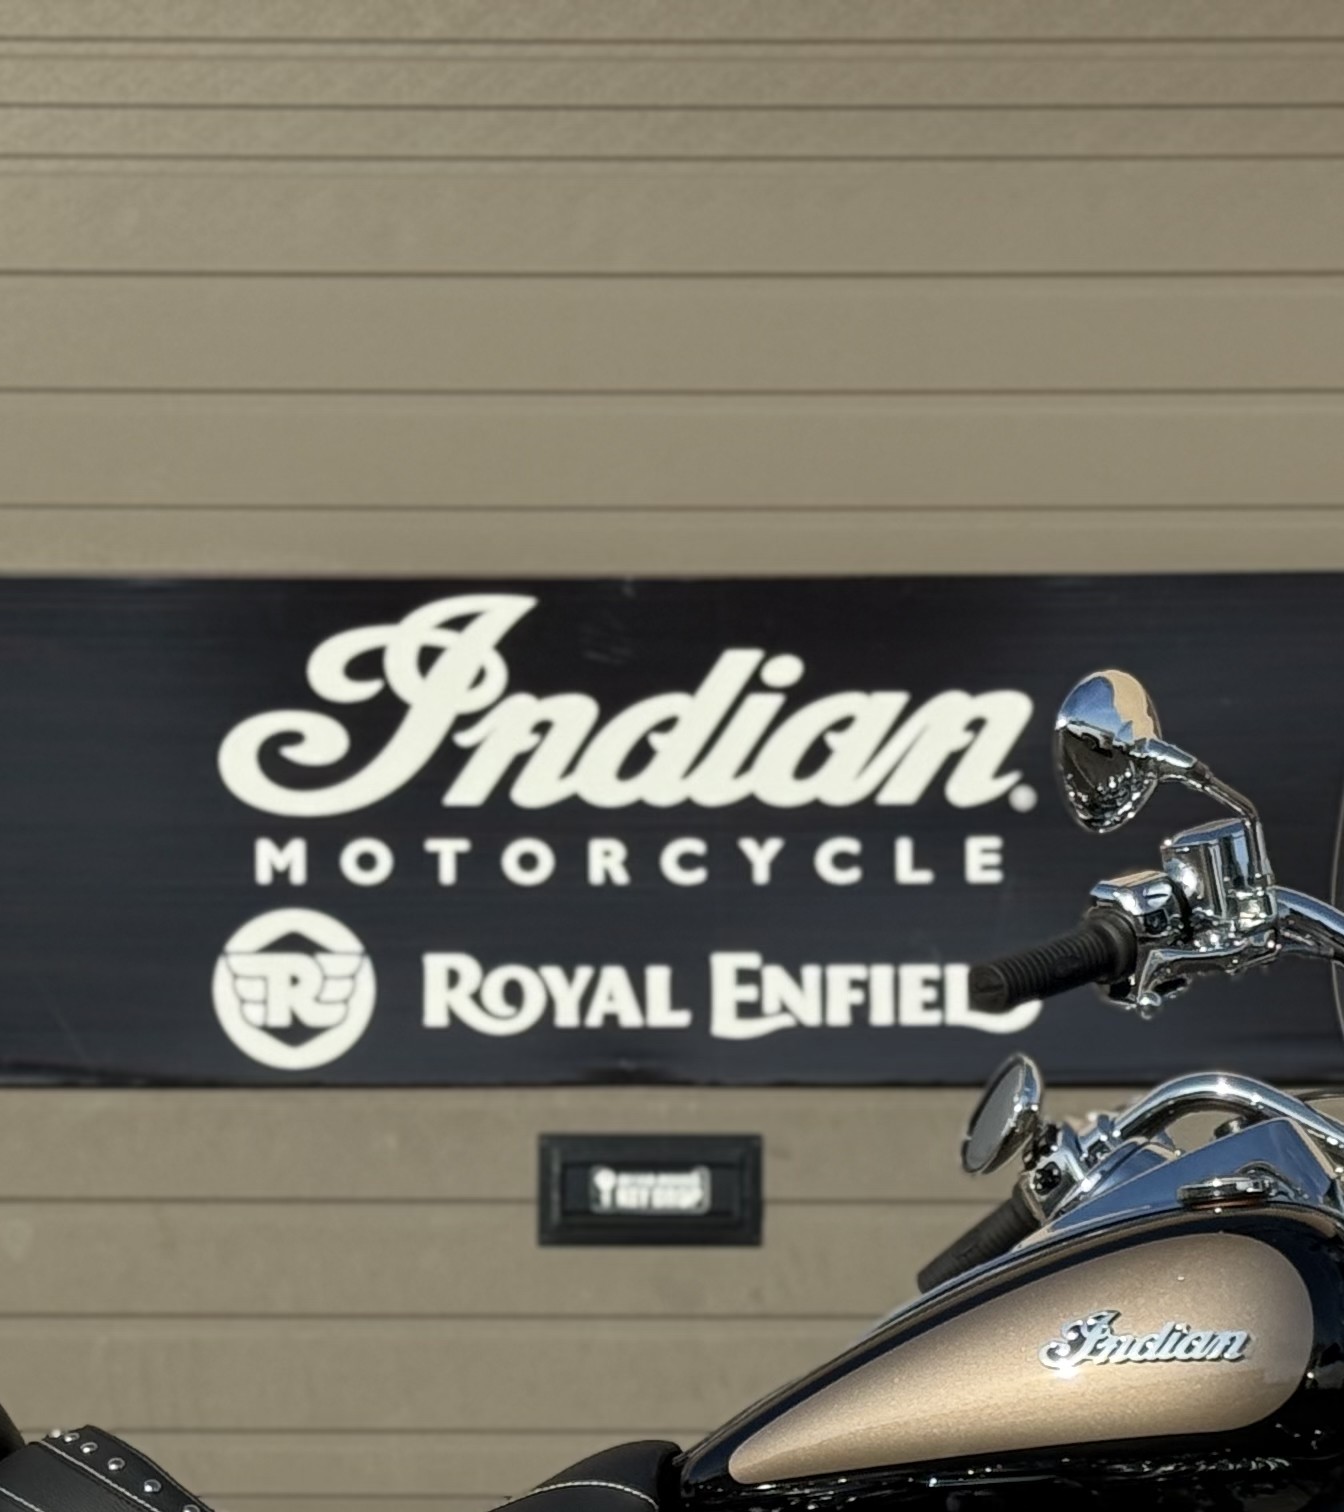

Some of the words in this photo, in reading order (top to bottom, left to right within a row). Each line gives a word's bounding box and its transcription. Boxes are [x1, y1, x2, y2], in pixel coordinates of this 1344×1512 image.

[256, 838, 1004, 885] MOTORCYCLE
[422, 952, 691, 1036] ROYAL
[711, 952, 1043, 1039] ENFIEL
[1039, 1310, 1250, 1372] Indian
